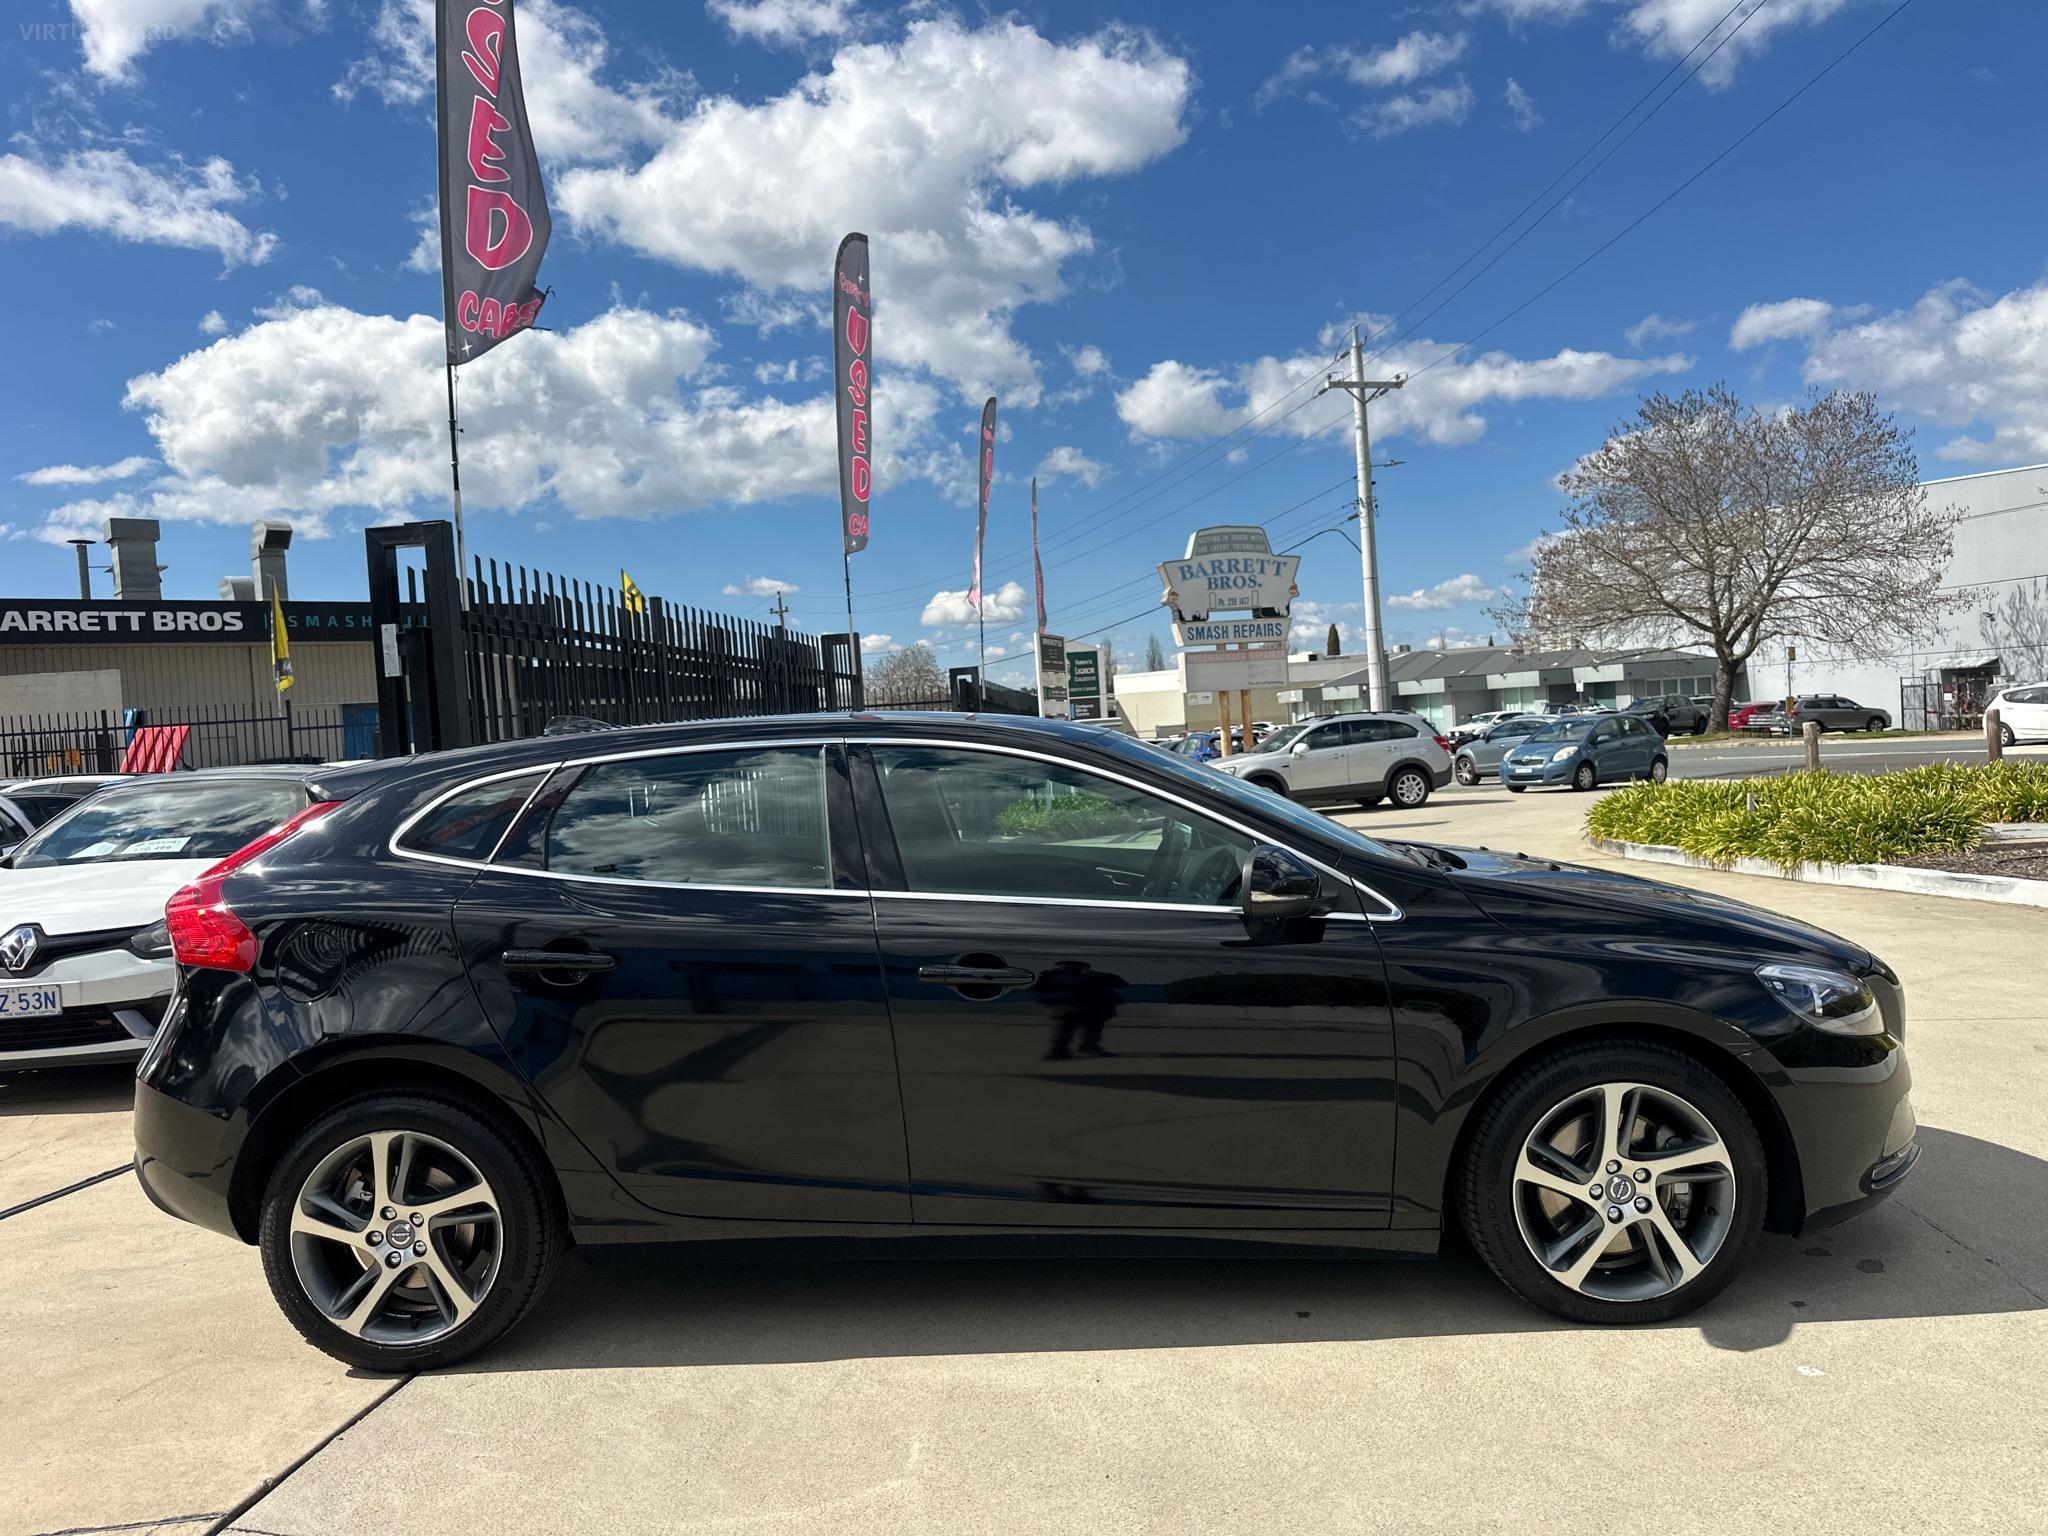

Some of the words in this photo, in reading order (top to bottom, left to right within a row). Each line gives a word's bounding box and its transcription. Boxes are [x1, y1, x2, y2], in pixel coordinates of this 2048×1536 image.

[462, 0, 533, 271] SED
[458, 290, 541, 339] CARS
[846, 305, 872, 502] USED
[1178, 557, 1288, 582] BARRETT
[1206, 574, 1263, 591] BROS.
[0, 610, 146, 632] ARRETT
[153, 610, 244, 632] BROS
[288, 614, 373, 629] SMASH
[1187, 625, 1229, 641] SMASH
[1233, 622, 1283, 638] REPAIRS
